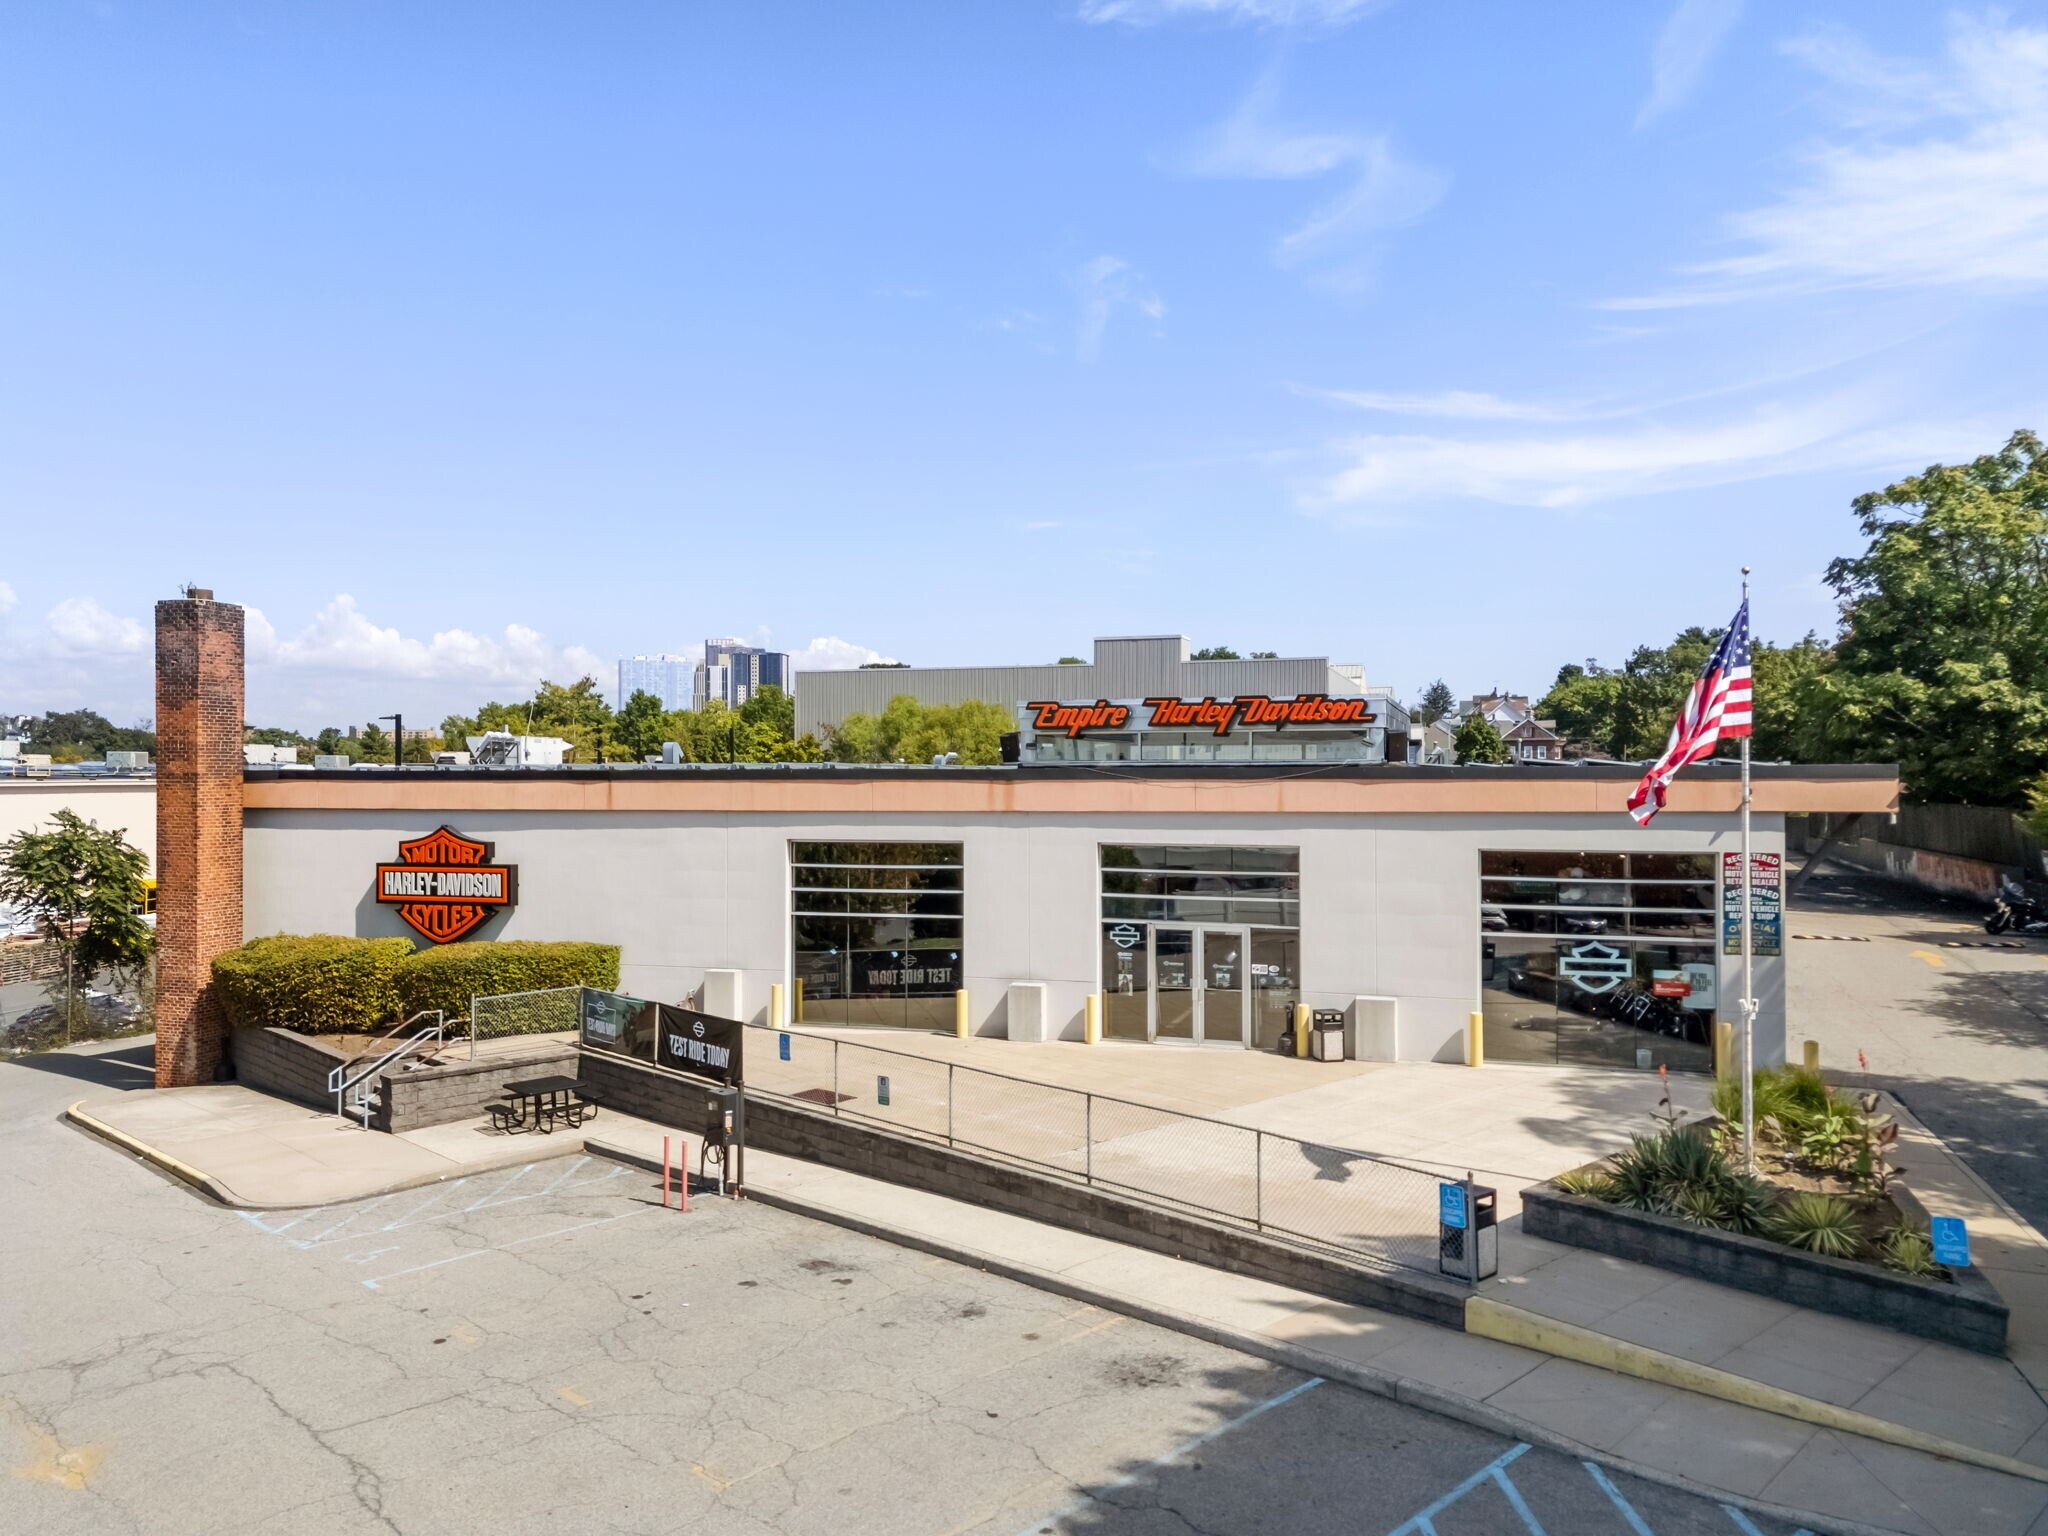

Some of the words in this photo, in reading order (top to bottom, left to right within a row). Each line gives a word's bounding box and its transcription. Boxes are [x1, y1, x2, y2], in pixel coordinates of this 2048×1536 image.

[1028, 701, 1128, 737] Empire
[1145, 696, 1373, 734] Harley-Davidson
[412, 837, 473, 864] MOTOR
[1726, 853, 1779, 865] REGTERED
[384, 871, 502, 897] HARLEY-DAVIDSON
[1752, 878, 1778, 886] DEALER
[1726, 888, 1779, 900] REGTERED
[1752, 905, 1780, 913] VEHICLE
[1756, 912, 1776, 920] SHOP
[411, 904, 474, 936] CYCLES
[669, 1034, 688, 1058] TEST
[688, 1039, 706, 1063] RIDE
[706, 1043, 730, 1069] TODAY
